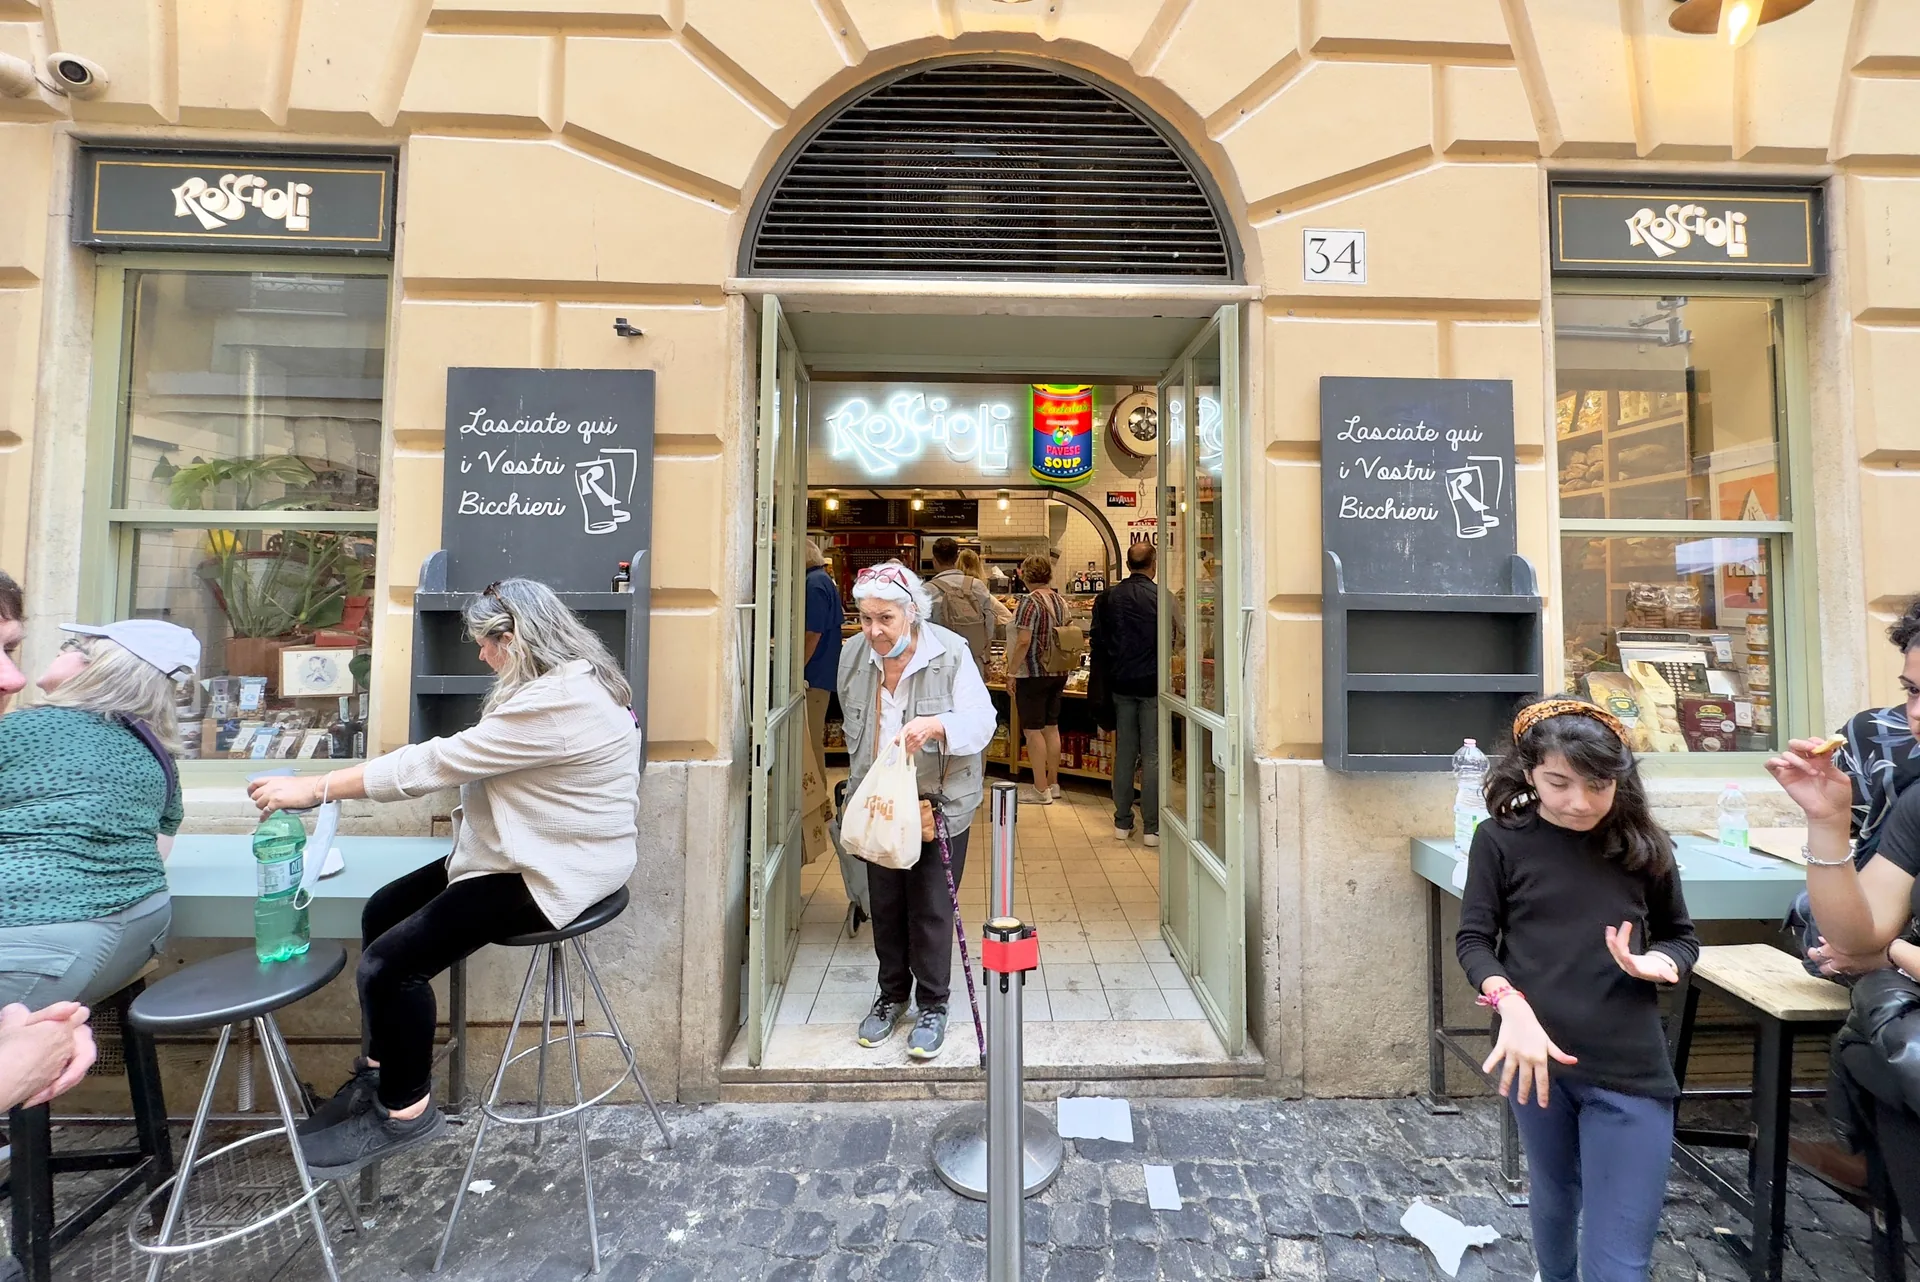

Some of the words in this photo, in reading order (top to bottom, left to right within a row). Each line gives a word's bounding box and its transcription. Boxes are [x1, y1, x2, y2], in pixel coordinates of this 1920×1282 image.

[1309, 238, 1362, 275] 34
[459, 407, 572, 436] Lasciate
[577, 416, 618, 444] qui
[1337, 415, 1439, 443] Lasciate
[1445, 425, 1484, 451] qui
[460, 455, 472, 474] i
[478, 449, 565, 475] Vostri
[1044, 456, 1082, 469] SOUP
[1046, 444, 1081, 455] PAVESE
[1339, 461, 1350, 479] i
[1355, 456, 1436, 481] Vostri
[457, 490, 567, 516] Bicchieri
[1338, 495, 1439, 521] Bicchieri
